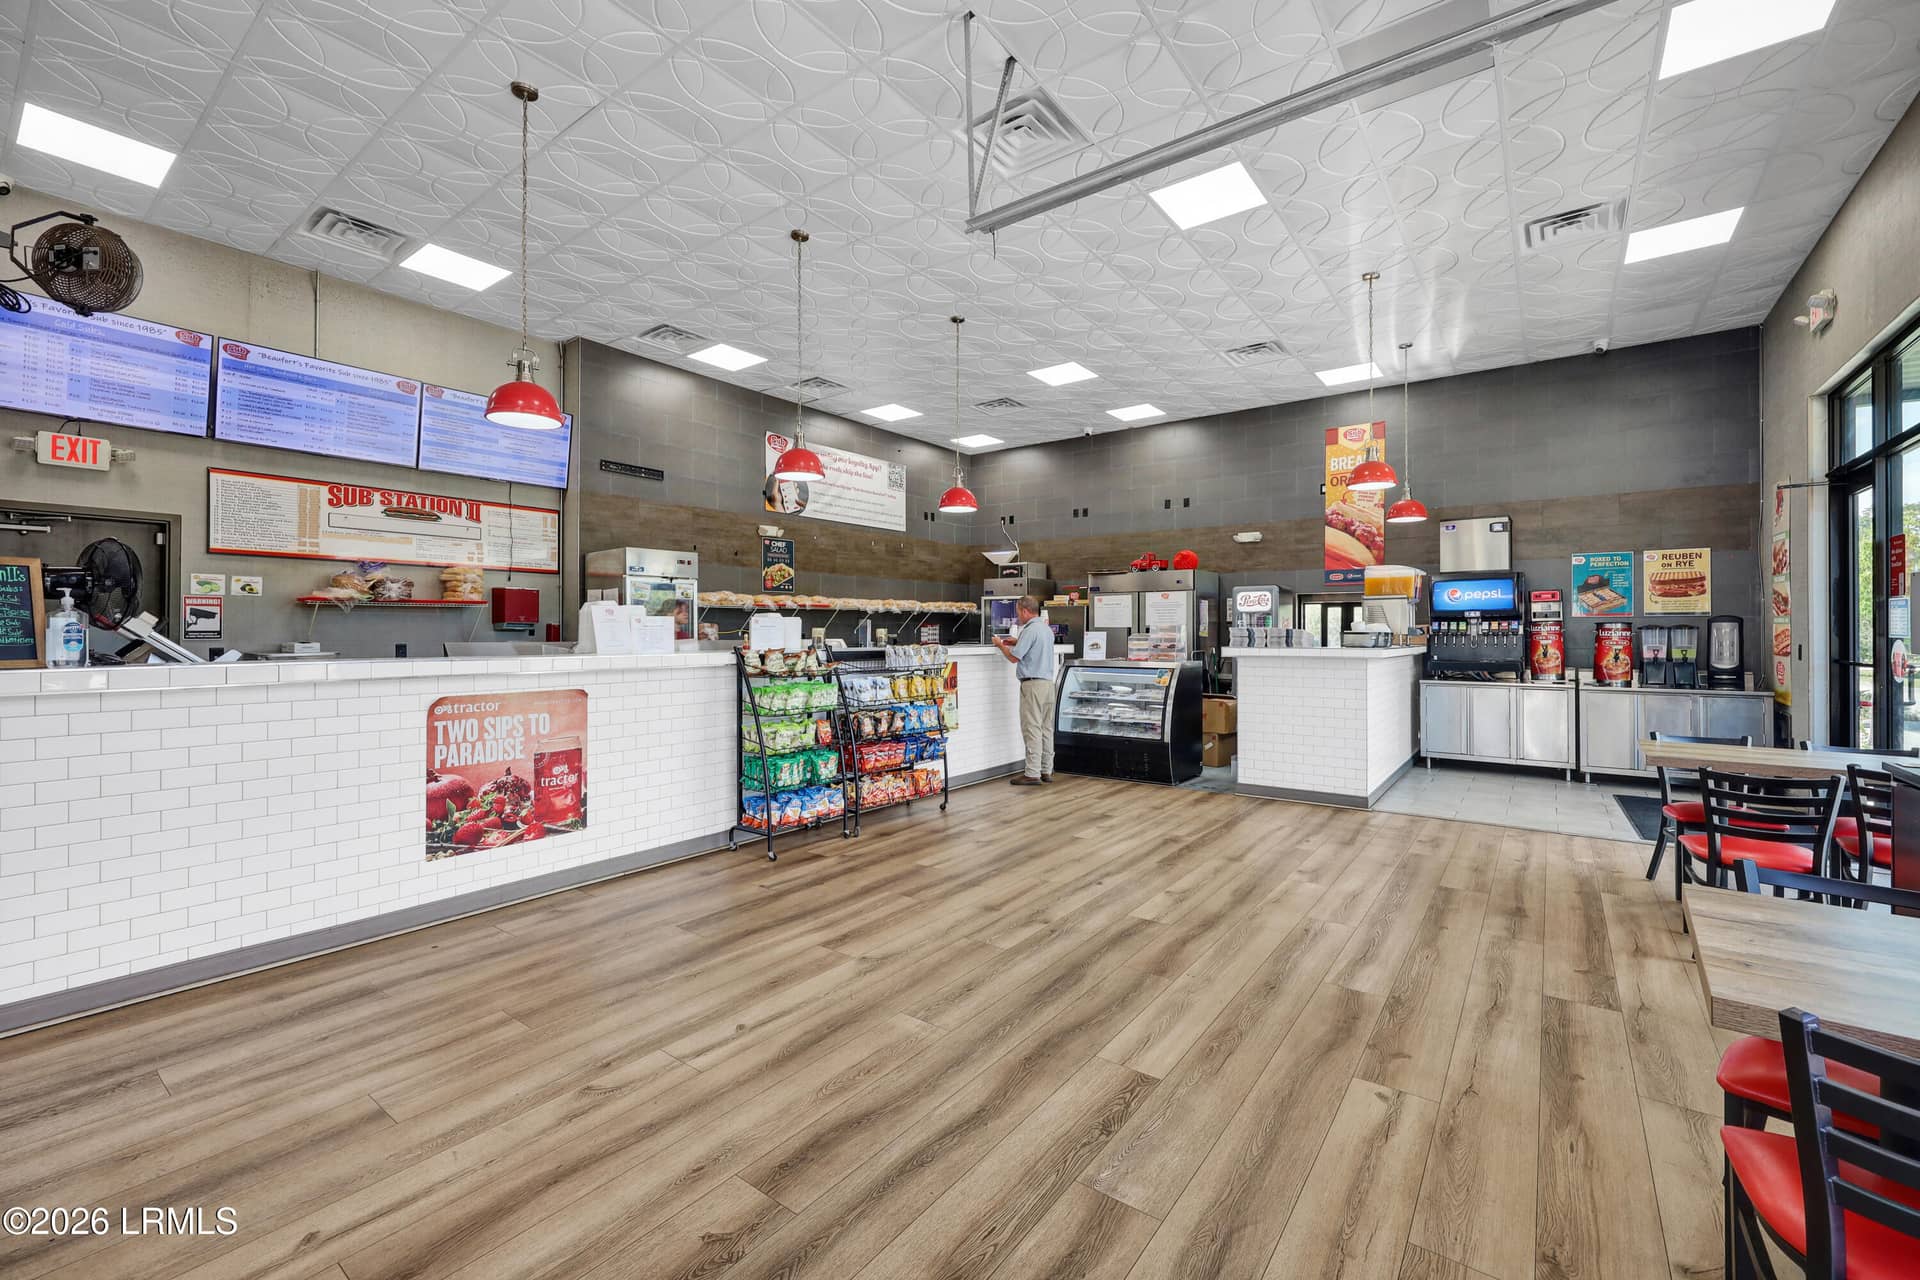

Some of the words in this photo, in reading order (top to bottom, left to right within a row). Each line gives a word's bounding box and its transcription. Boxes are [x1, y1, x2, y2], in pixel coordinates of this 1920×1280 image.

[51, 435, 101, 465] EXIT
[328, 485, 374, 508] SUB
[380, 491, 463, 517] STATION
[466, 502, 481, 523] II
[1661, 552, 1702, 560] REUBEN
[1464, 588, 1502, 601] pepsi
[454, 703, 500, 714] tractor
[434, 718, 479, 744] TWO
[483, 714, 524, 740] SIPS
[528, 713, 550, 736] TO
[434, 737, 526, 769] PARADISE
[541, 773, 578, 787] tractor
